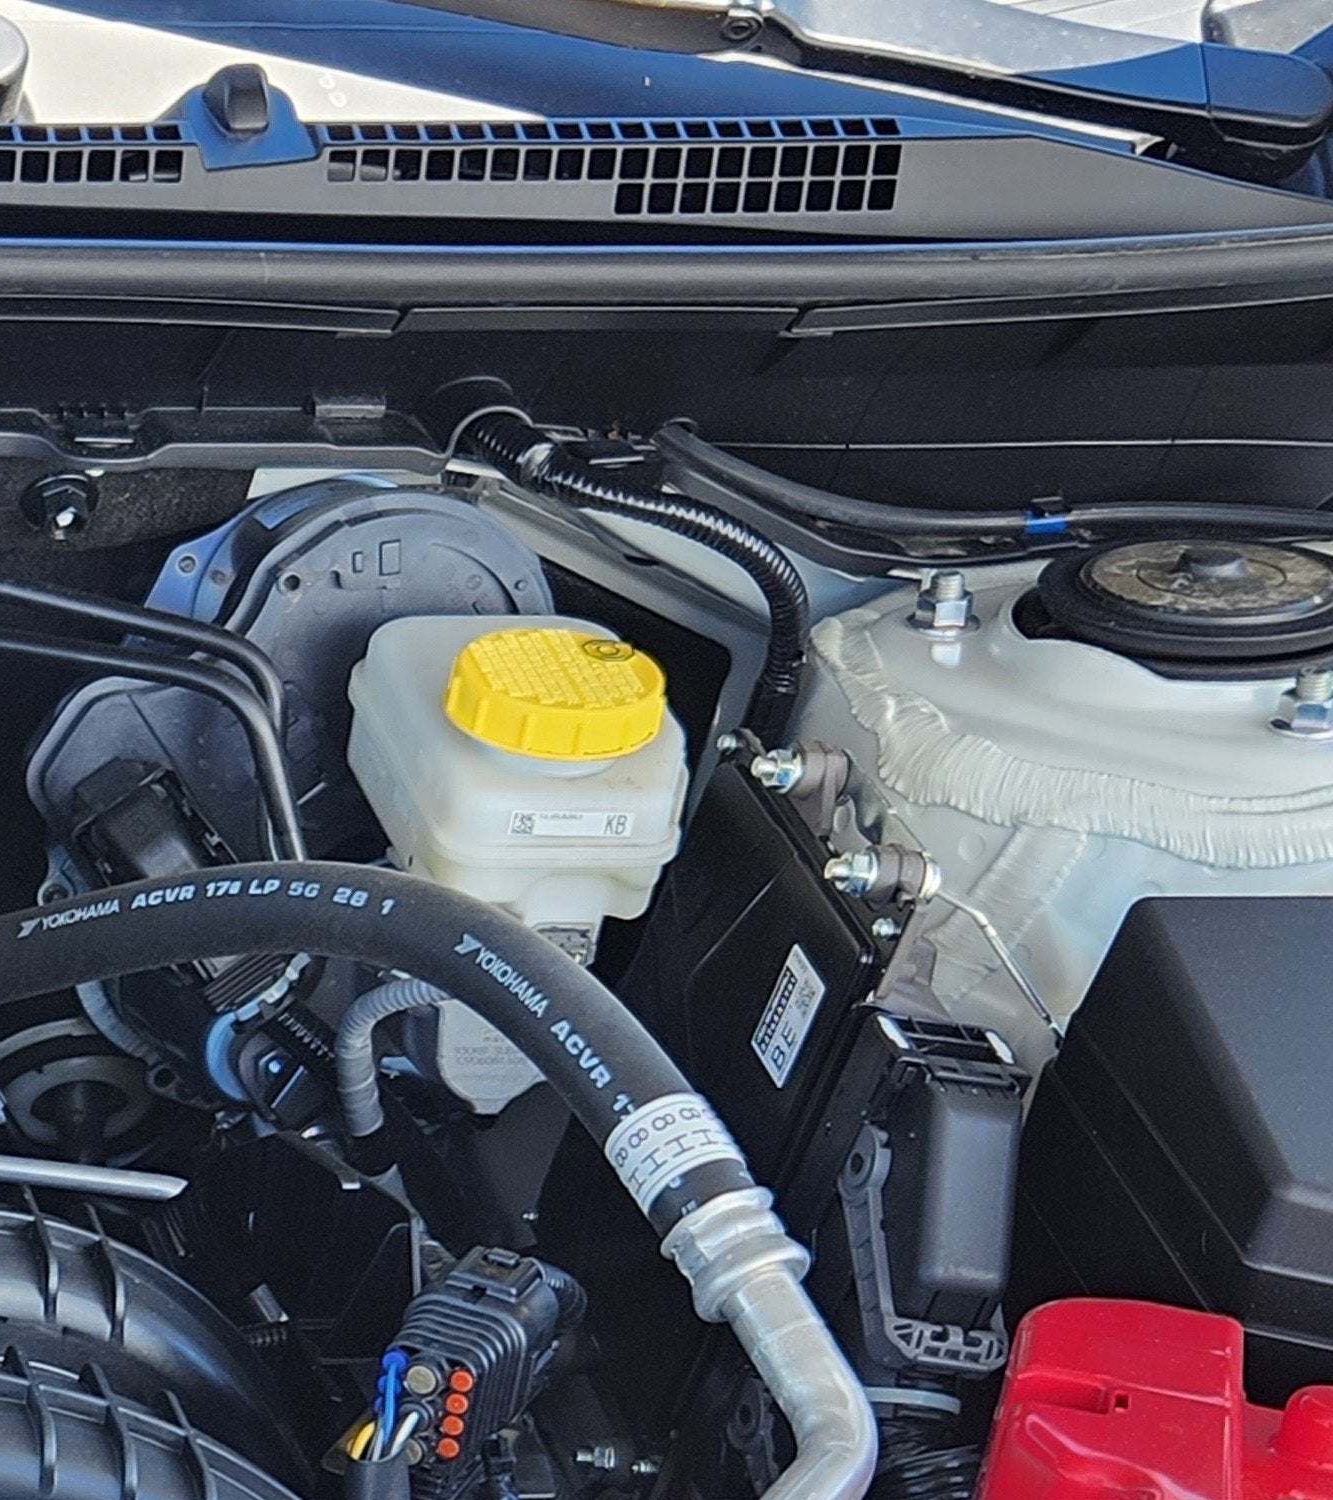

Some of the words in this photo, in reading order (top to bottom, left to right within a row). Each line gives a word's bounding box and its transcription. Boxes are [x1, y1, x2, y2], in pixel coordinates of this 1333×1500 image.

[602, 814, 628, 835] KB
[41, 899, 120, 931] YOKOHAMA
[131, 884, 196, 910] ACVR
[248, 879, 281, 895] LP
[475, 946, 551, 1019] YOKOHAMA
[550, 1019, 615, 1089] ACVR
